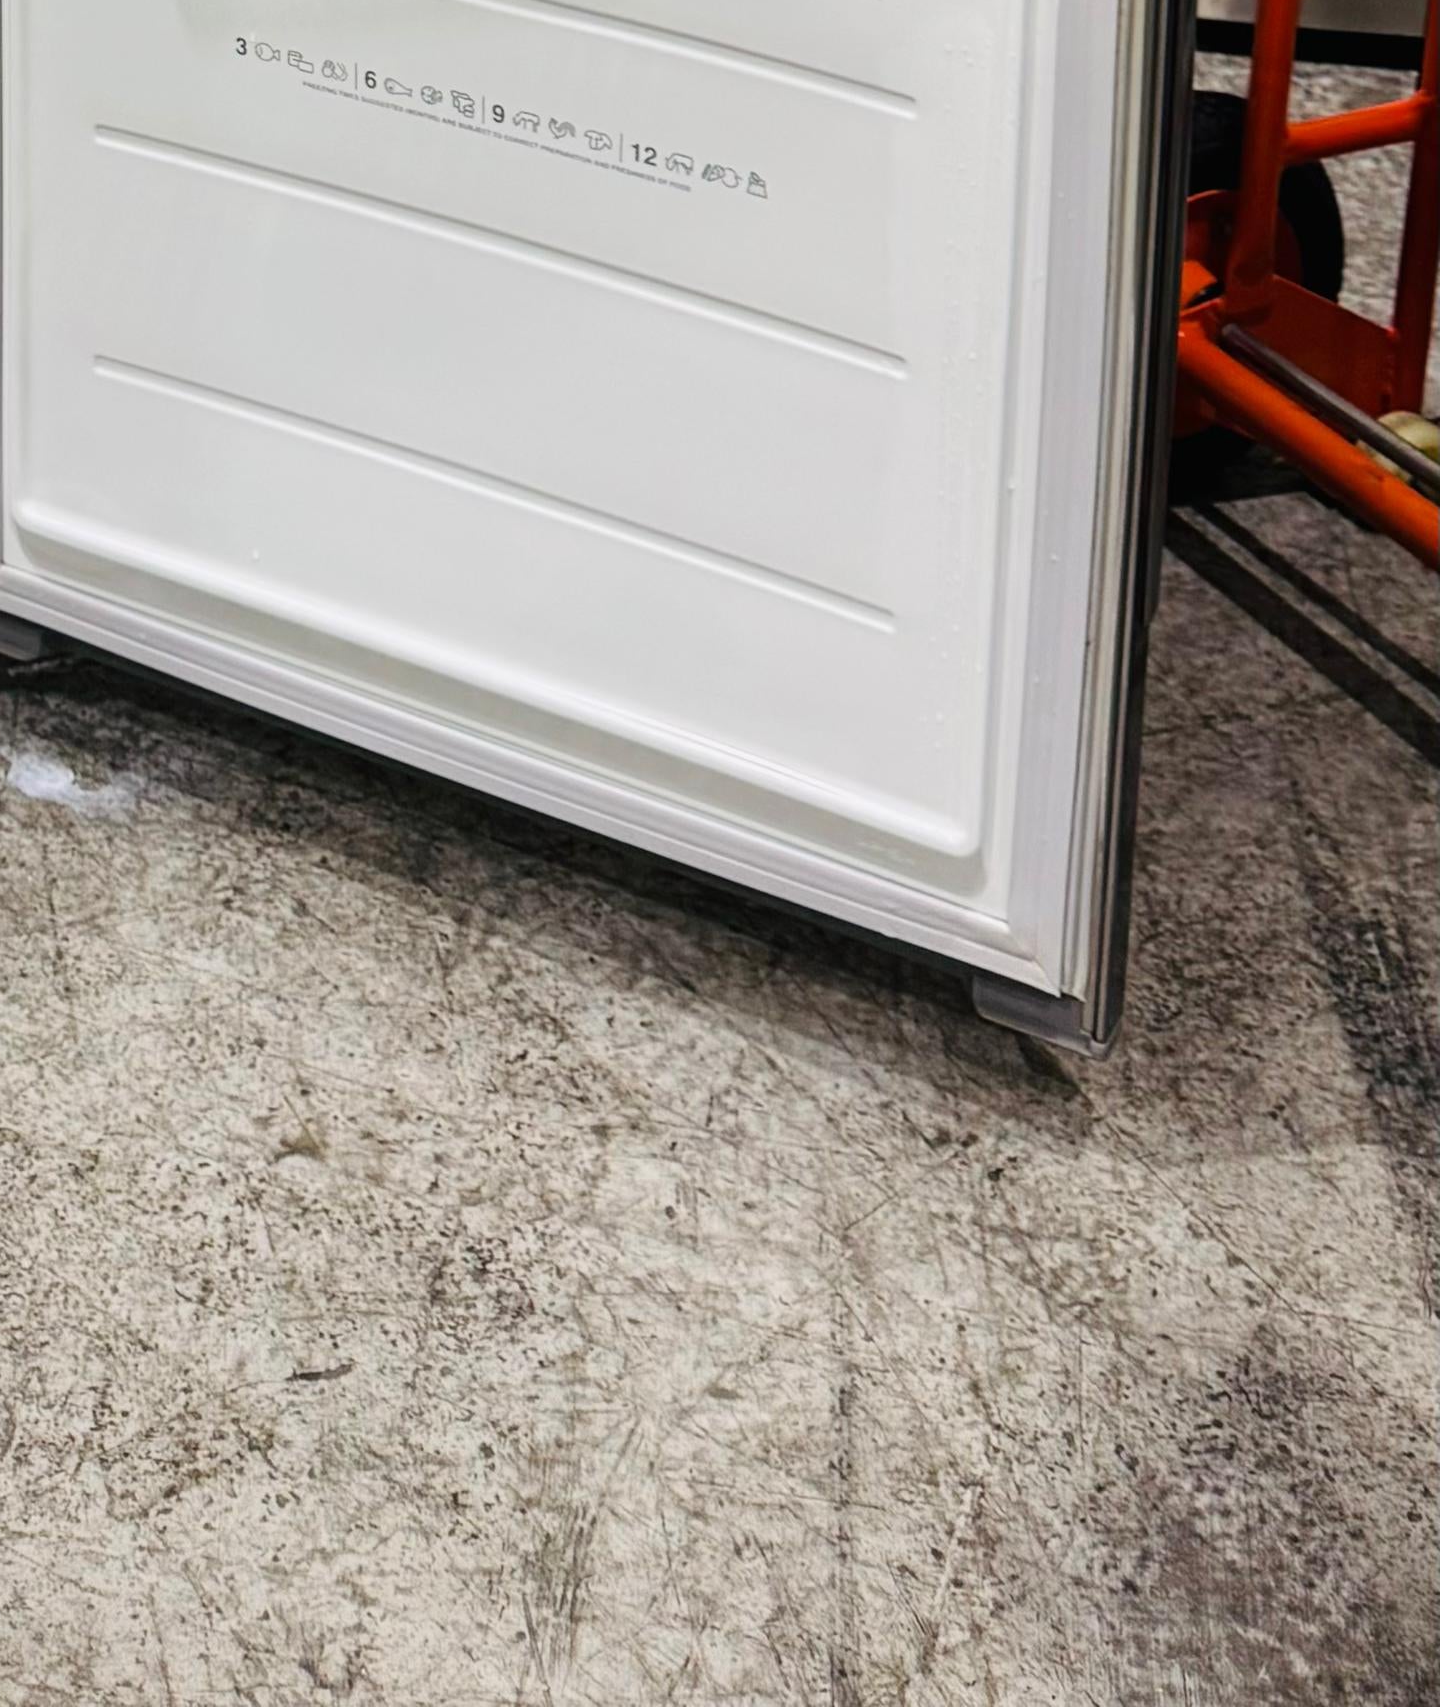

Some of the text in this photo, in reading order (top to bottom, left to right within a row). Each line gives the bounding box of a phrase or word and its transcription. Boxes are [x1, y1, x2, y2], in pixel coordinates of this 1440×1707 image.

[236, 37, 657, 167] 3 6 9 12
